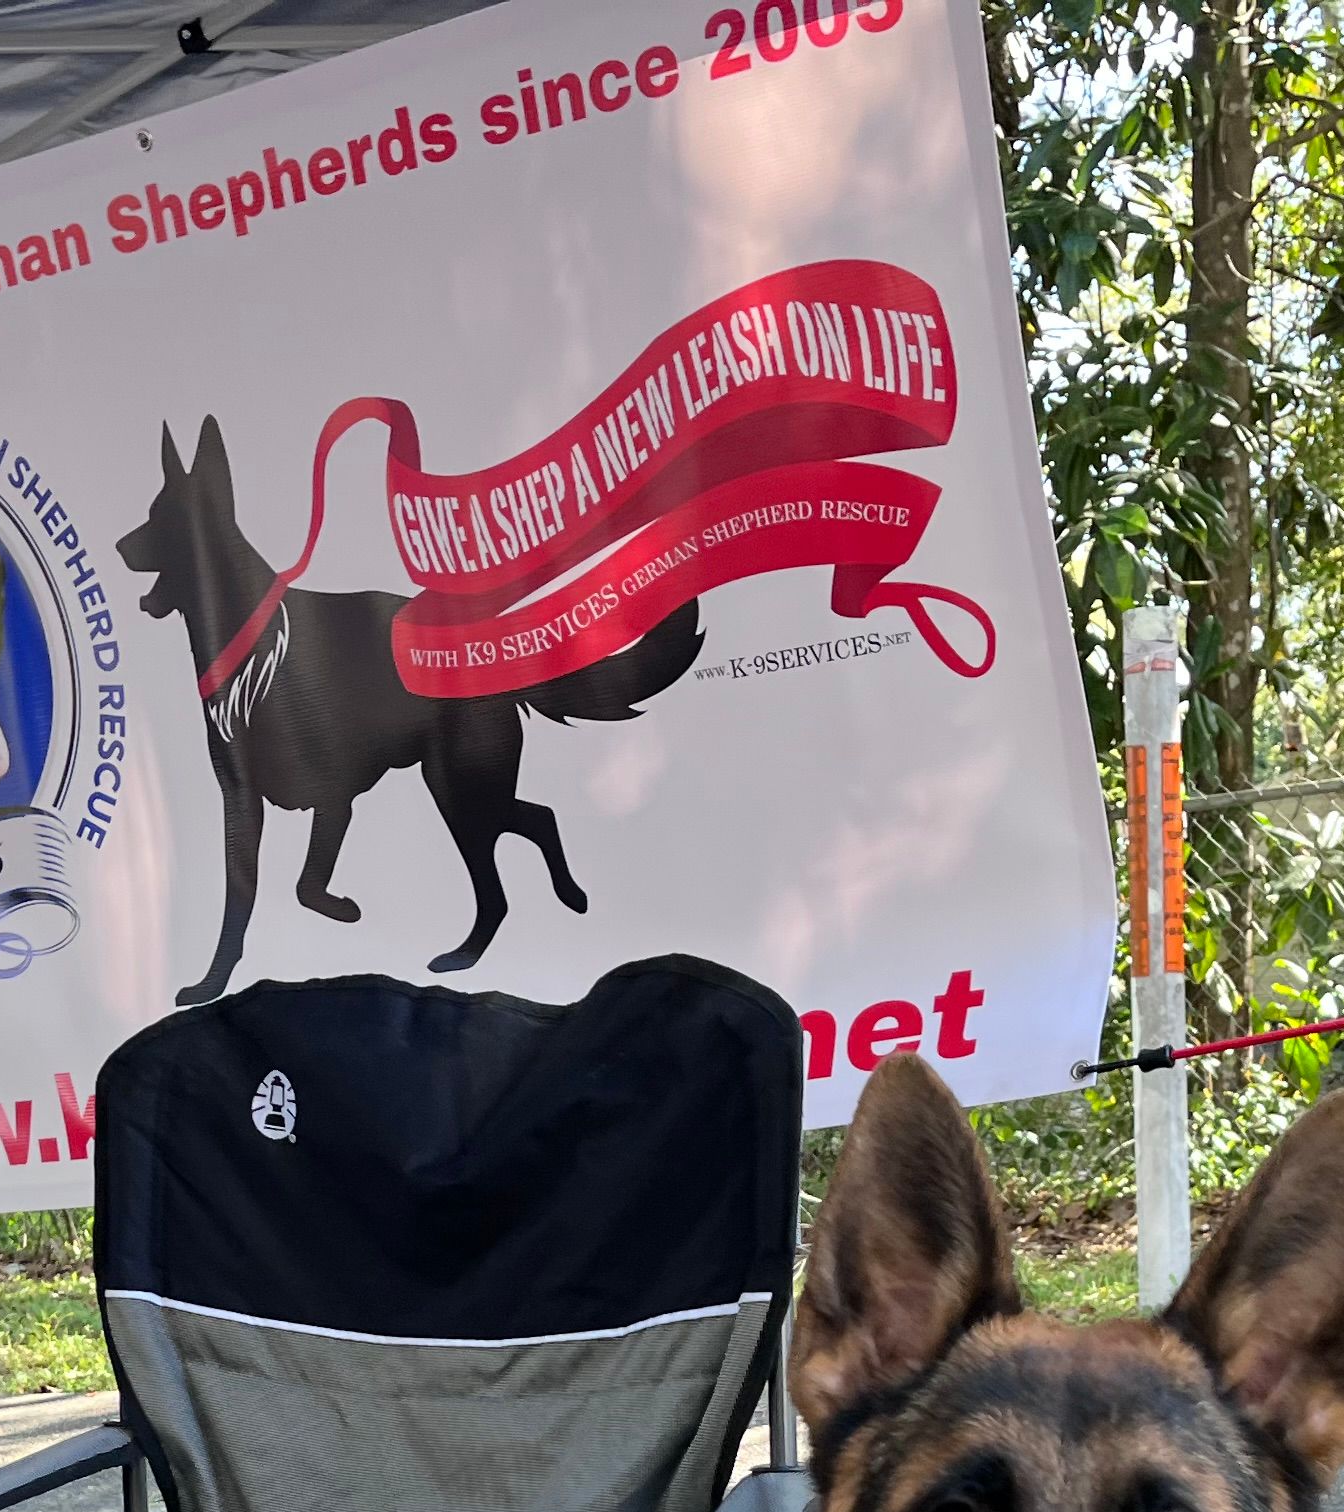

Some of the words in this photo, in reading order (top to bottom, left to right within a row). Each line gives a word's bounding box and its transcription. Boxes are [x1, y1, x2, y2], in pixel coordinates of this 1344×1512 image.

[107, 105, 457, 256] Shepherds
[481, 43, 680, 146] since
[394, 492, 478, 574] GIVE
[470, 494, 502, 570] A
[490, 461, 566, 560] SHEP
[570, 443, 601, 516] A
[593, 364, 675, 493] NEW
[671, 303, 787, 421] LEASH
[786, 301, 851, 382] ON
[850, 305, 947, 403] LIFE
[8, 456, 121, 672] SHEPHERD
[76, 683, 126, 849] RESCUE
[410, 648, 458, 668] WITH
[465, 641, 498, 667] K9
[501, 583, 620, 662] SERVICES
[621, 534, 701, 596] GERMAN
[701, 501, 814, 546] SHEPHERD
[820, 500, 911, 527] RESCUE
